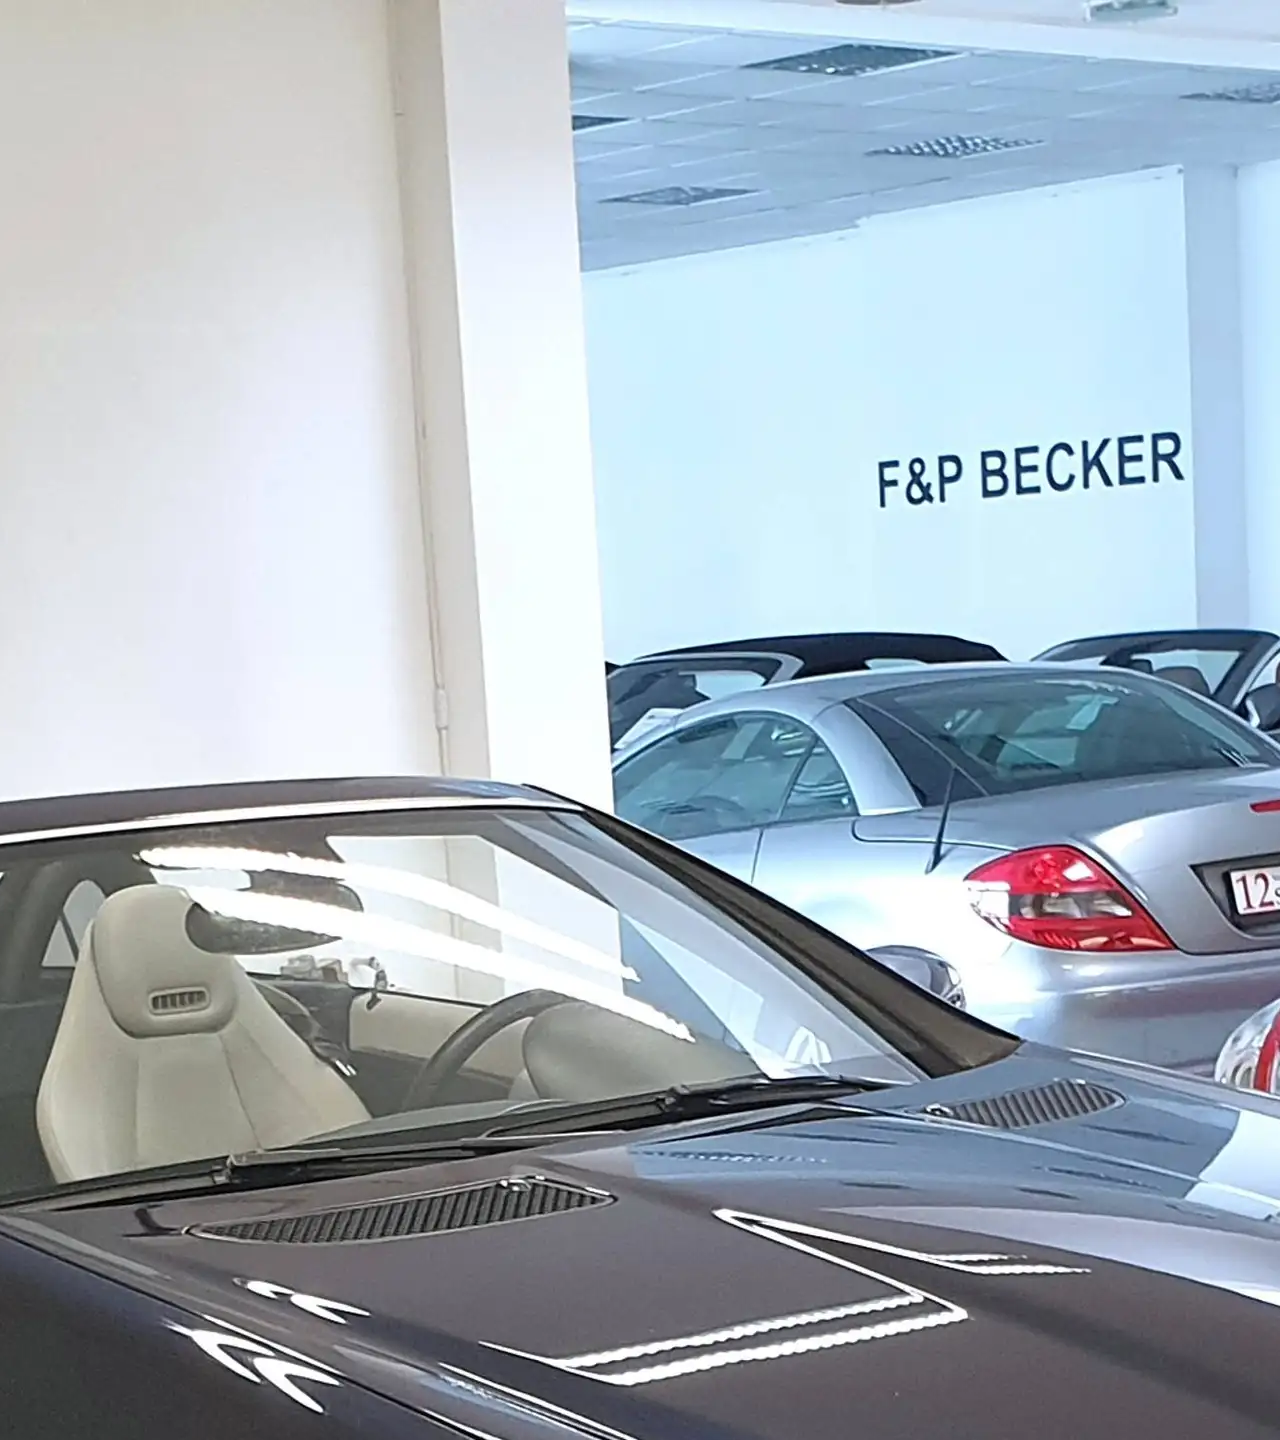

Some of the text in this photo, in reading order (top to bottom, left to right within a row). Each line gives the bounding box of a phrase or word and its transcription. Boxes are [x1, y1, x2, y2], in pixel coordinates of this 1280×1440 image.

[878, 431, 1185, 509] F&P BECKER
[1235, 872, 1275, 911] 12
